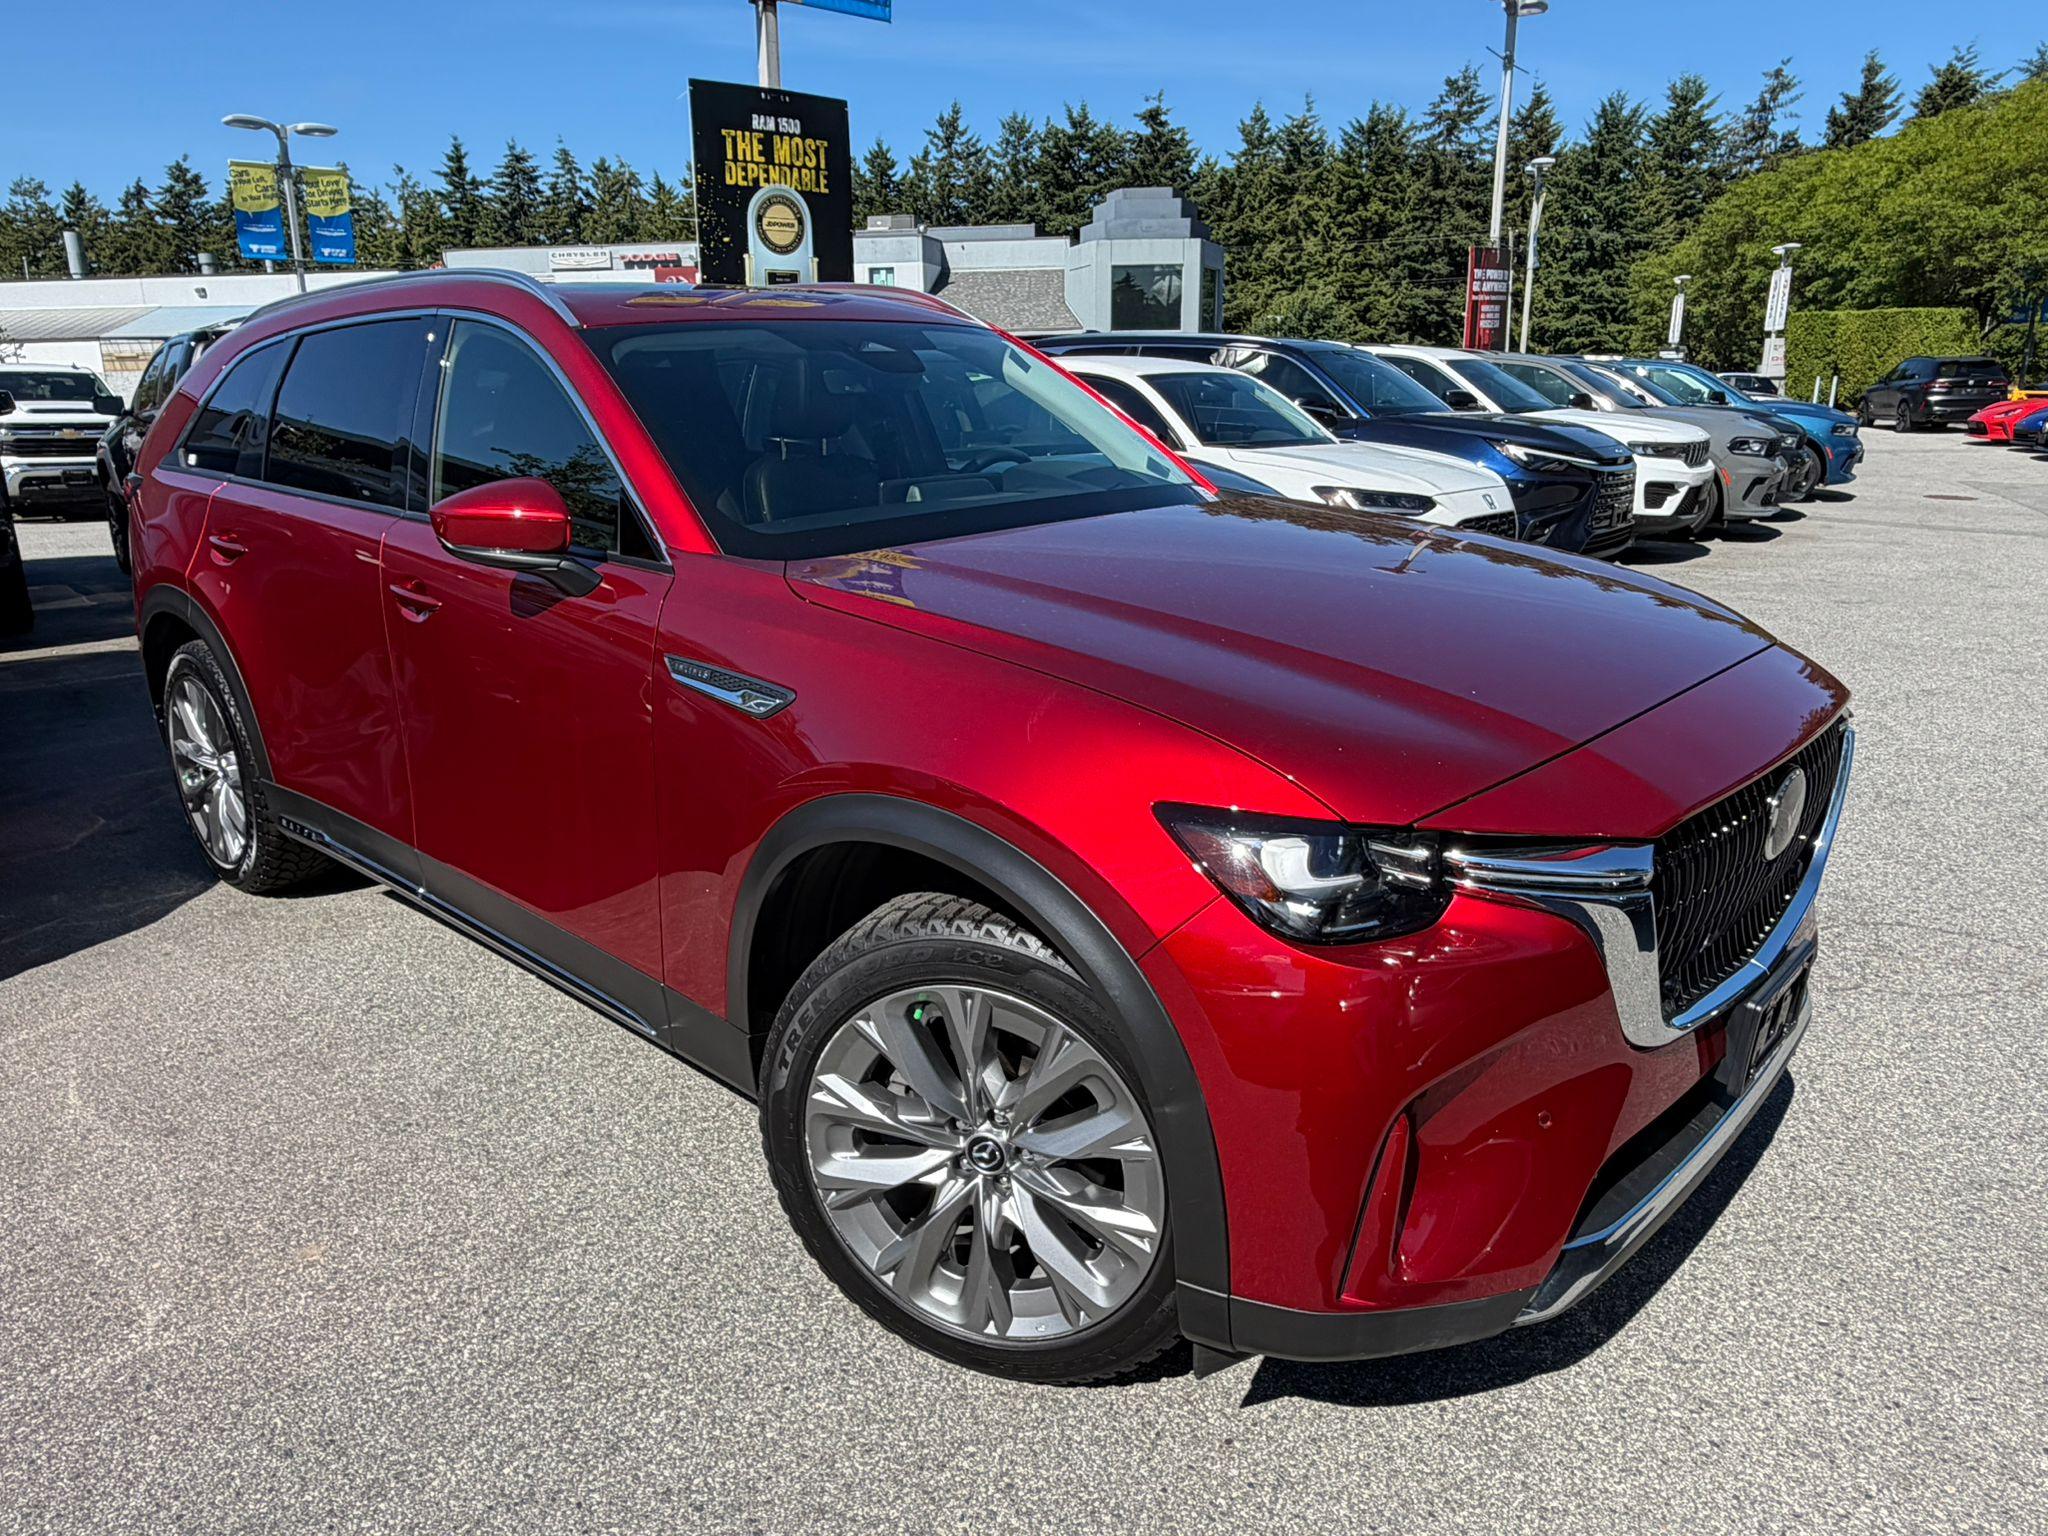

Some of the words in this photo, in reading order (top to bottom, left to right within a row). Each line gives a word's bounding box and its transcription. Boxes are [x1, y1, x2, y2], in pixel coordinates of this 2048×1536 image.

[752, 114, 775, 131] RAM
[777, 117, 801, 134] 1500
[721, 129, 765, 163] THE
[773, 135, 828, 169] MOST
[725, 161, 829, 193] DEPENDABLE
[619, 253, 678, 262] DODGE
[778, 986, 831, 1071] TREK
